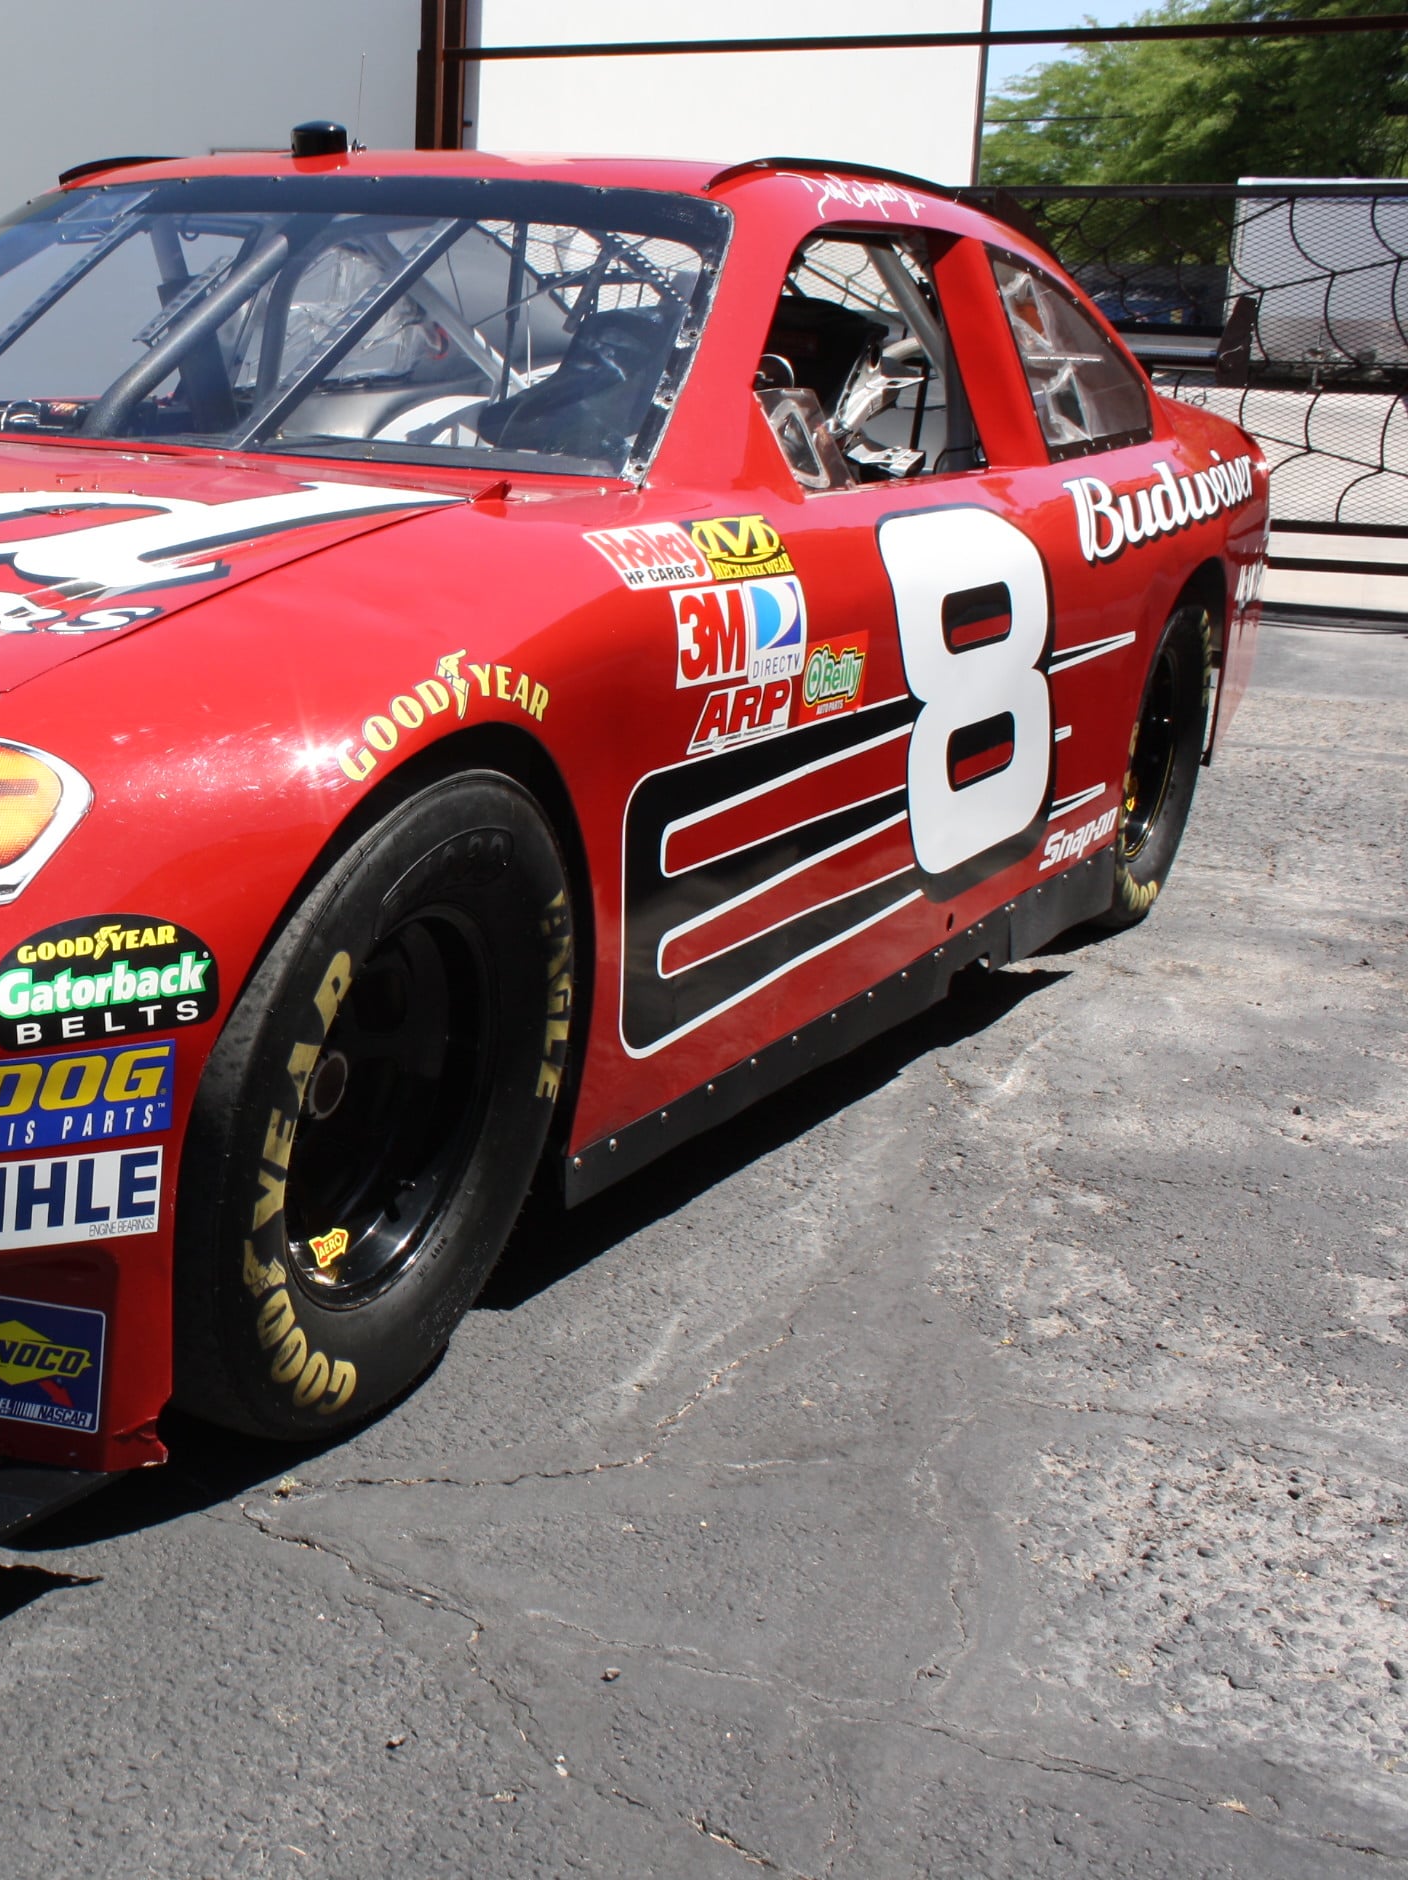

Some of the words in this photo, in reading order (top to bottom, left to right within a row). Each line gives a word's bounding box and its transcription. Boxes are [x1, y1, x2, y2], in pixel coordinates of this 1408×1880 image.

[1063, 449, 1253, 562] Budweiser
[587, 528, 706, 577] Holley
[624, 570, 645, 585] HP
[648, 564, 695, 582] CARBS
[764, 552, 794, 575] WEAR
[679, 590, 746, 682] 3M
[752, 652, 801, 679] DIRECTV
[805, 647, 863, 703] O'Reilly
[693, 680, 791, 743] ARP
[878, 507, 1048, 875] 8
[1038, 806, 1119, 872] Snap-on
[17, 1000, 199, 1045] BELTS
[62, 1104, 154, 1141] PARTS
[89, 1221, 117, 1238] ENGINE
[117, 1216, 155, 1233] BEARINGS
[318, 1233, 343, 1258] AERO
[38, 1405, 88, 1427] NASCAR
